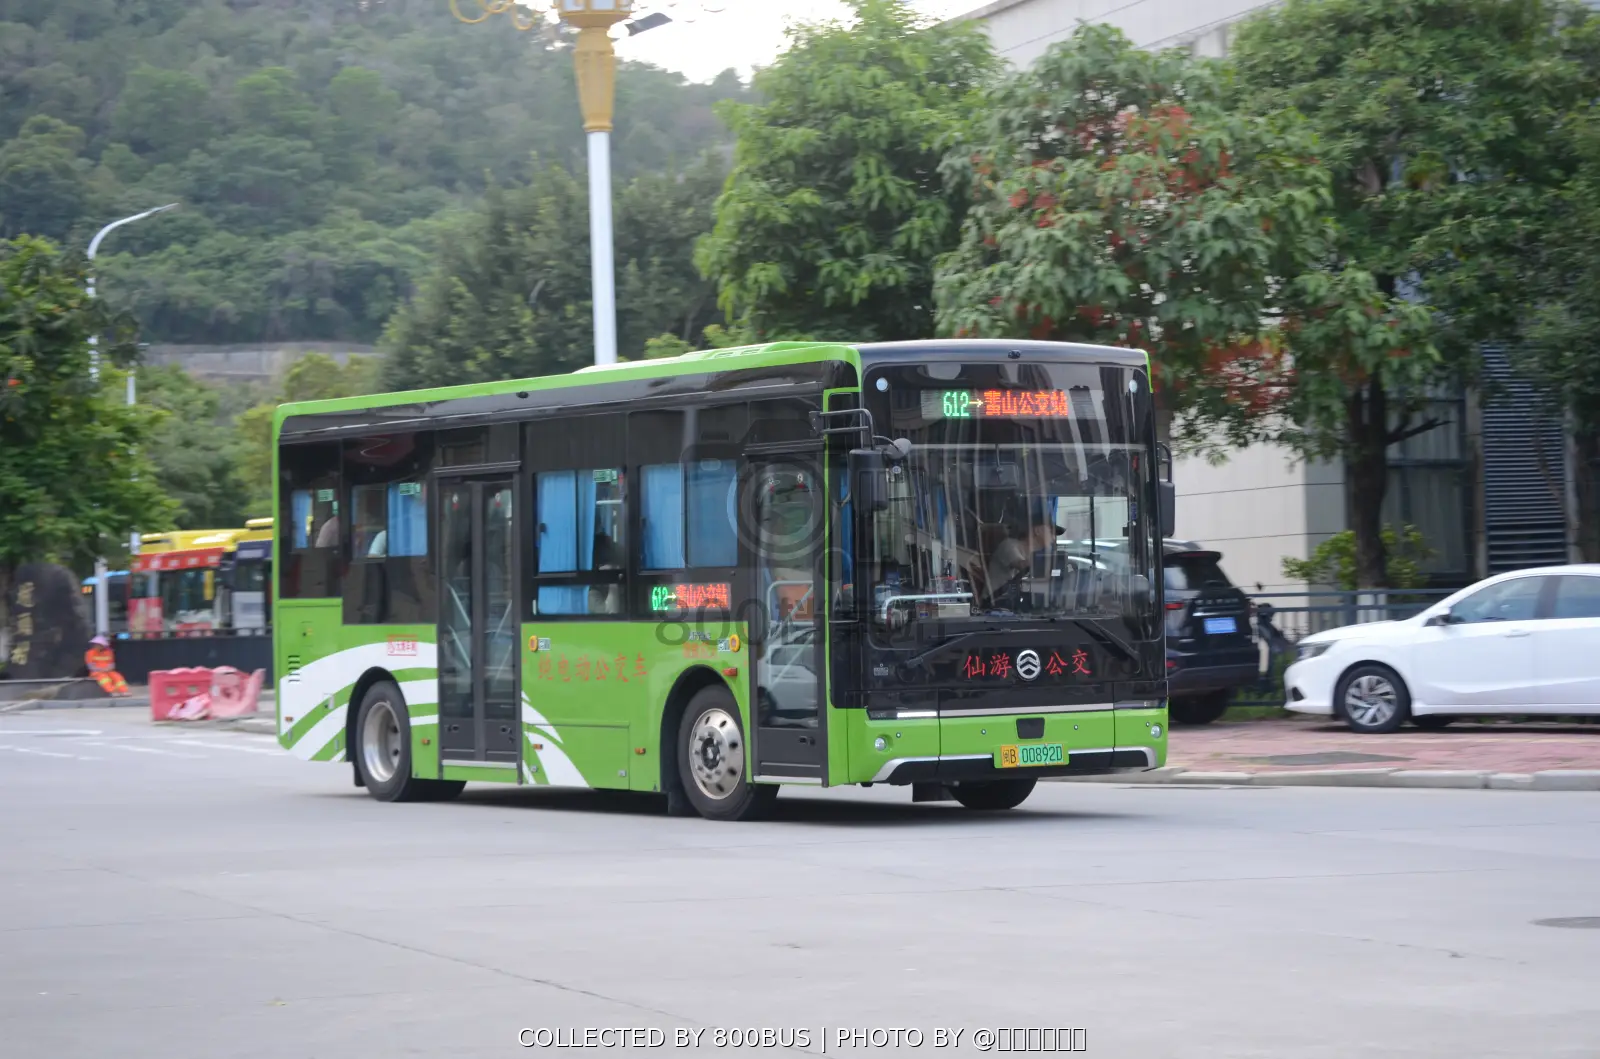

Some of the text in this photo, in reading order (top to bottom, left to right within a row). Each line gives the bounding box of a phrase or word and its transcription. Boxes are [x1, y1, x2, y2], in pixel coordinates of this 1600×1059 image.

[943, 391, 970, 417] 612
[652, 586, 669, 611] 612
[963, 649, 1092, 679] 仙游 公交
